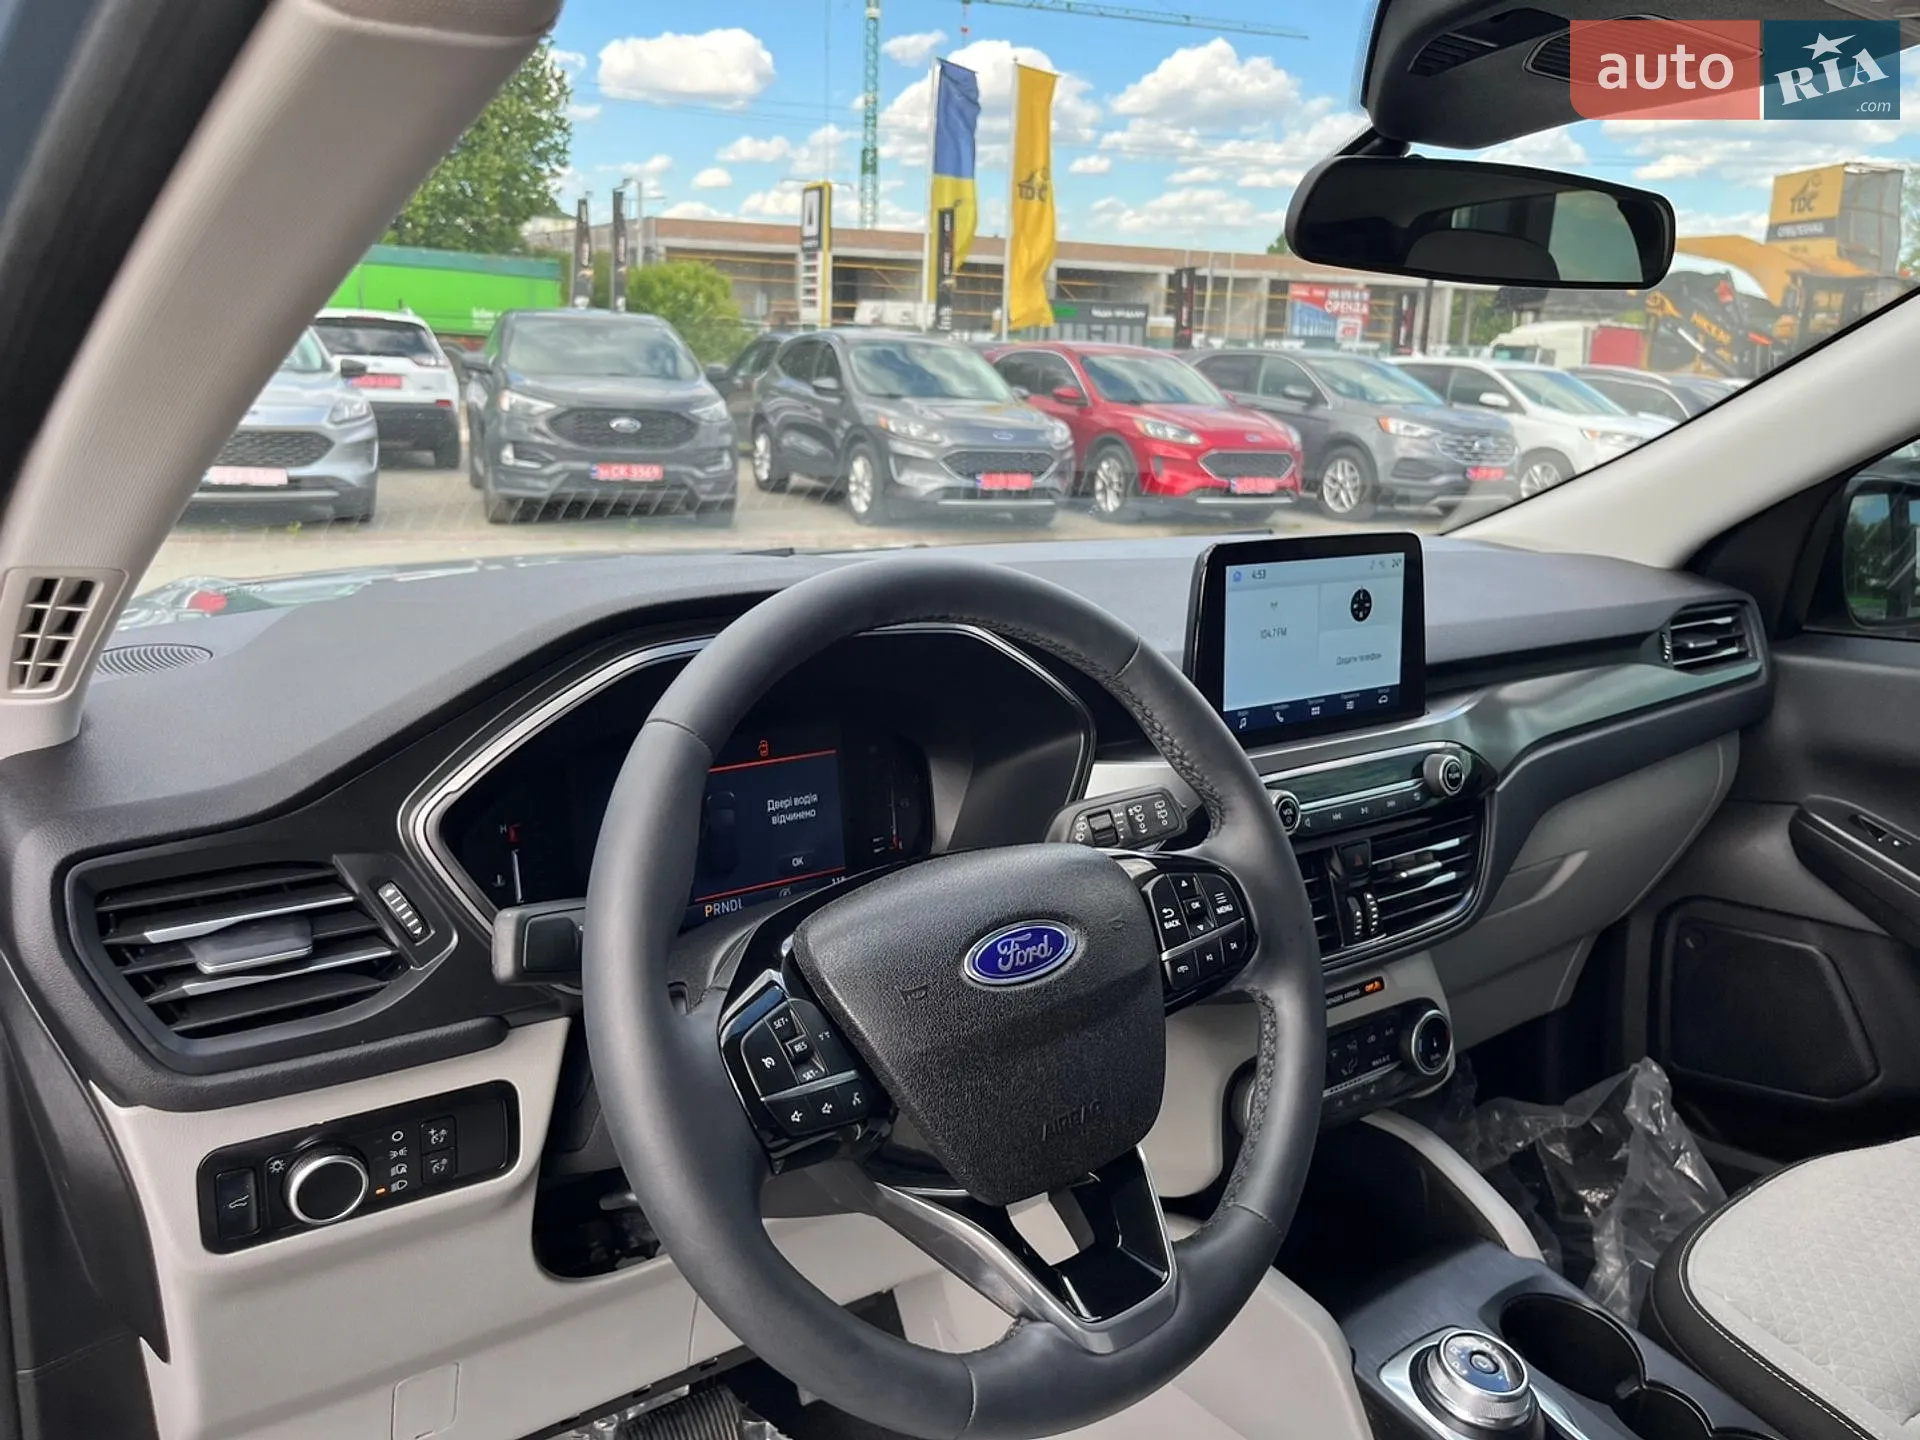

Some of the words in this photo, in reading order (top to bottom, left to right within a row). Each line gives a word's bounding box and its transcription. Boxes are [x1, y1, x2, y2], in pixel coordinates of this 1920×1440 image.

[767, 796, 792, 812] Двері
[793, 792, 818, 807] водія
[771, 808, 816, 825] відчинено
[997, 932, 1053, 971] Ford
